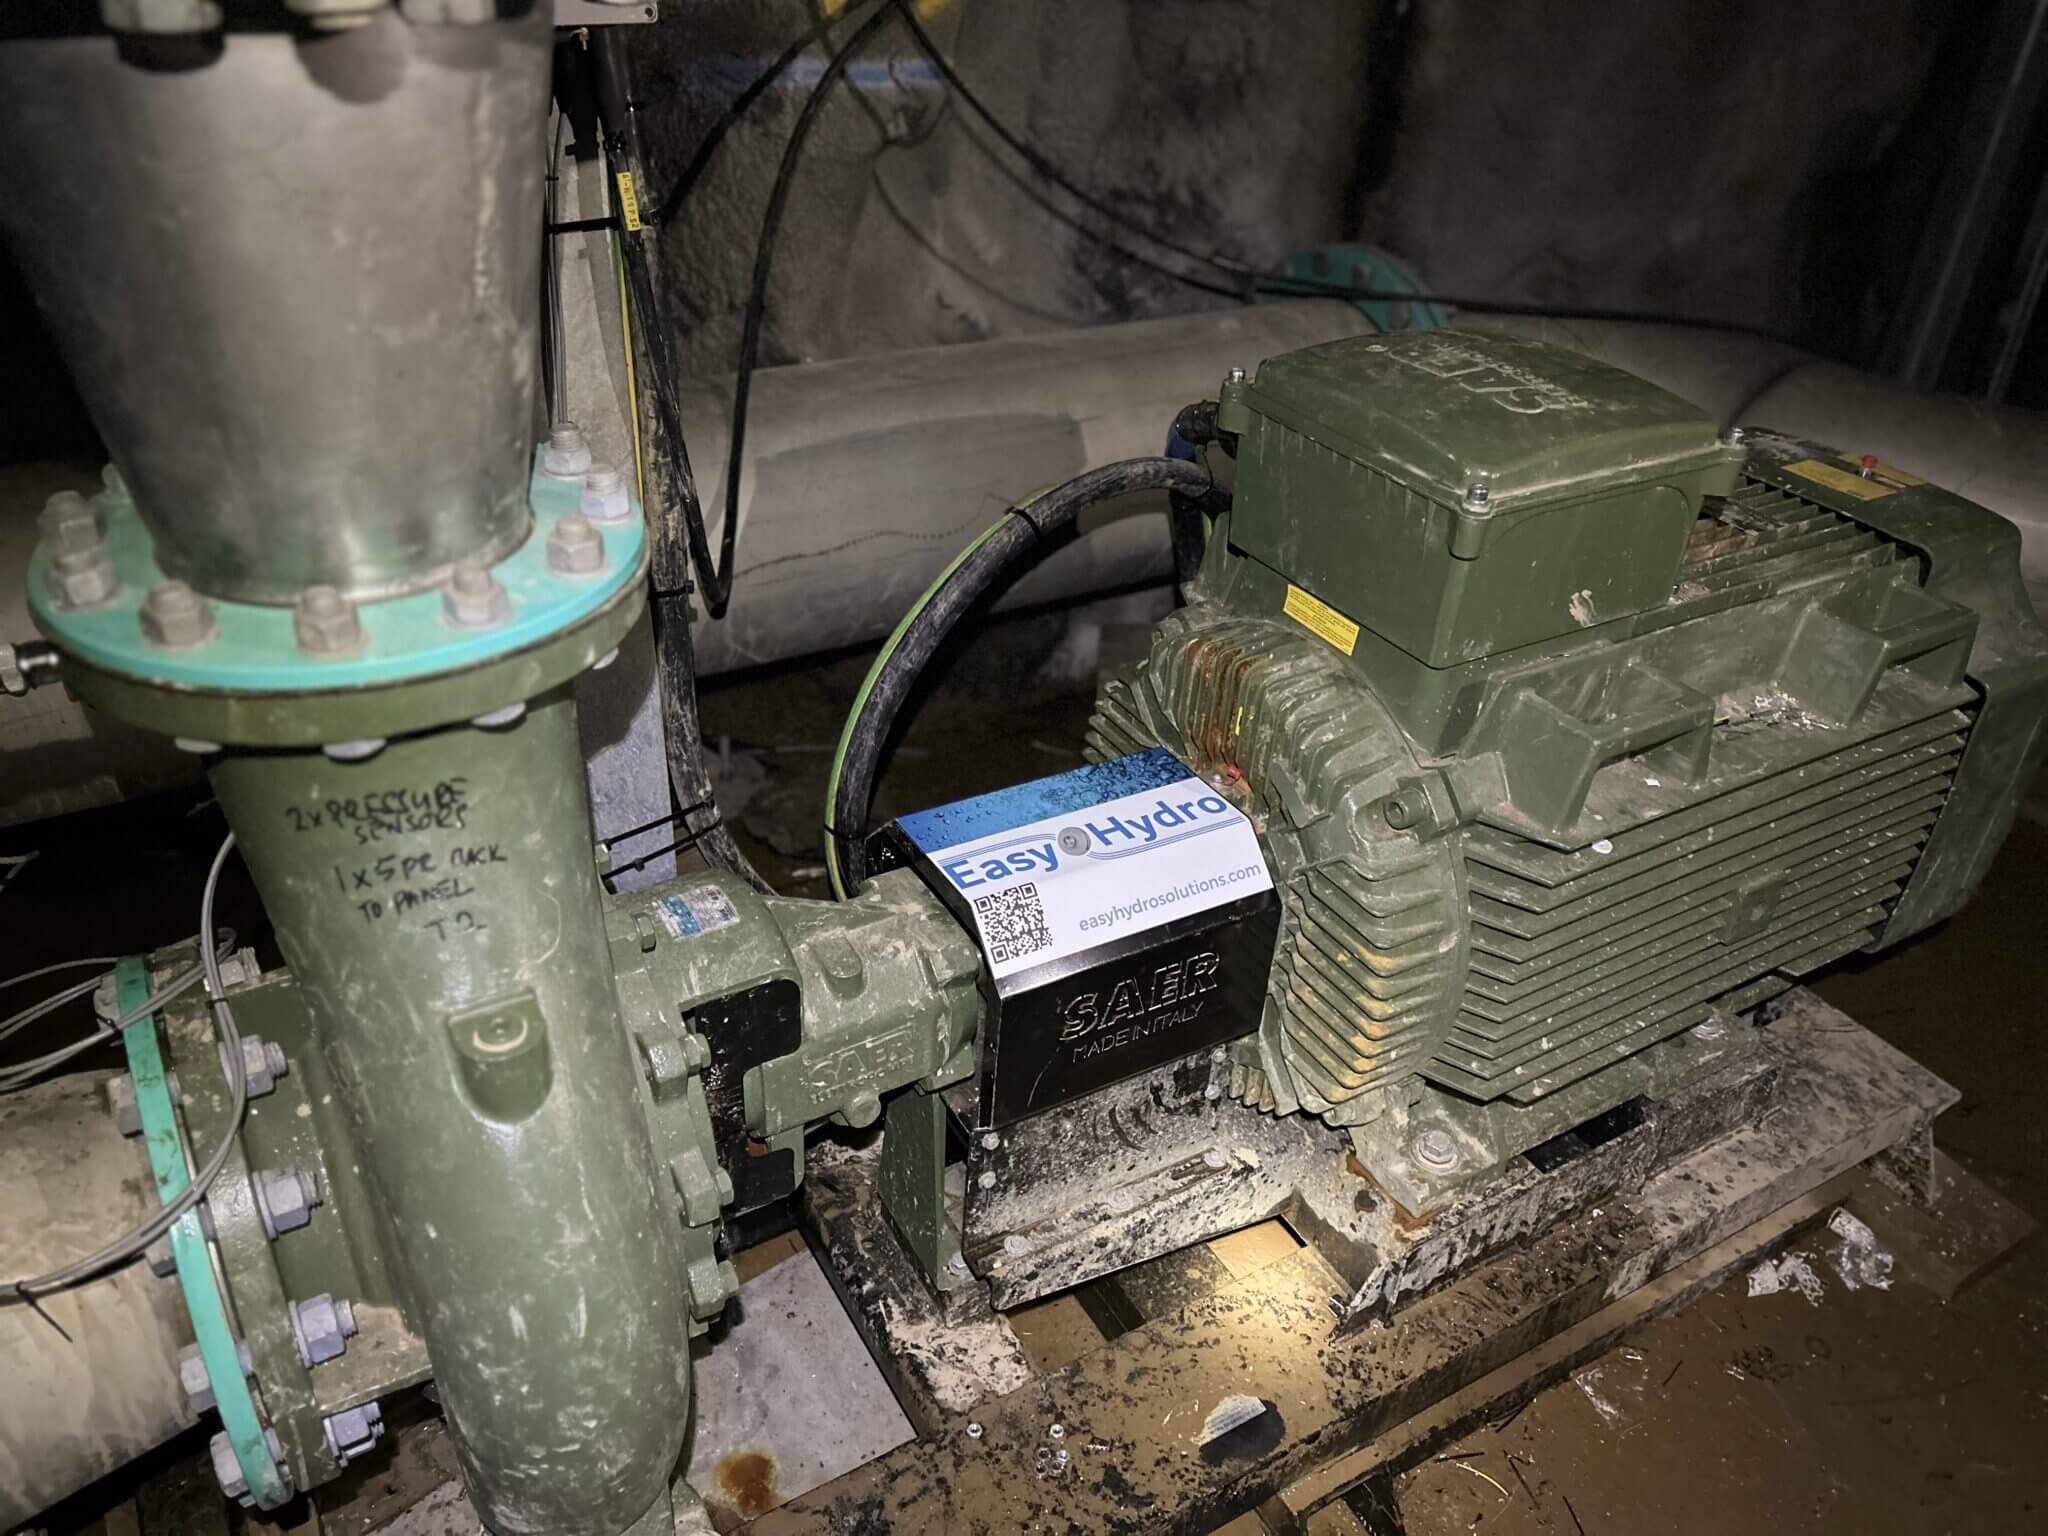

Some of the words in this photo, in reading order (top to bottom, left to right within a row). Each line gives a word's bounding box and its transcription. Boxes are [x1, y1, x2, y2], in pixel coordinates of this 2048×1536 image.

[943, 843, 1060, 890] Easy
[1085, 796, 1228, 847] Hydro
[394, 878, 475, 916] PANEL
[1079, 863, 1262, 931] easyhydrosolutions.com
[1058, 952, 1221, 1041] SAER
[1072, 1028, 1131, 1064] MADE
[1132, 1020, 1151, 1041] IN
[1152, 1001, 1205, 1033] ITALY
